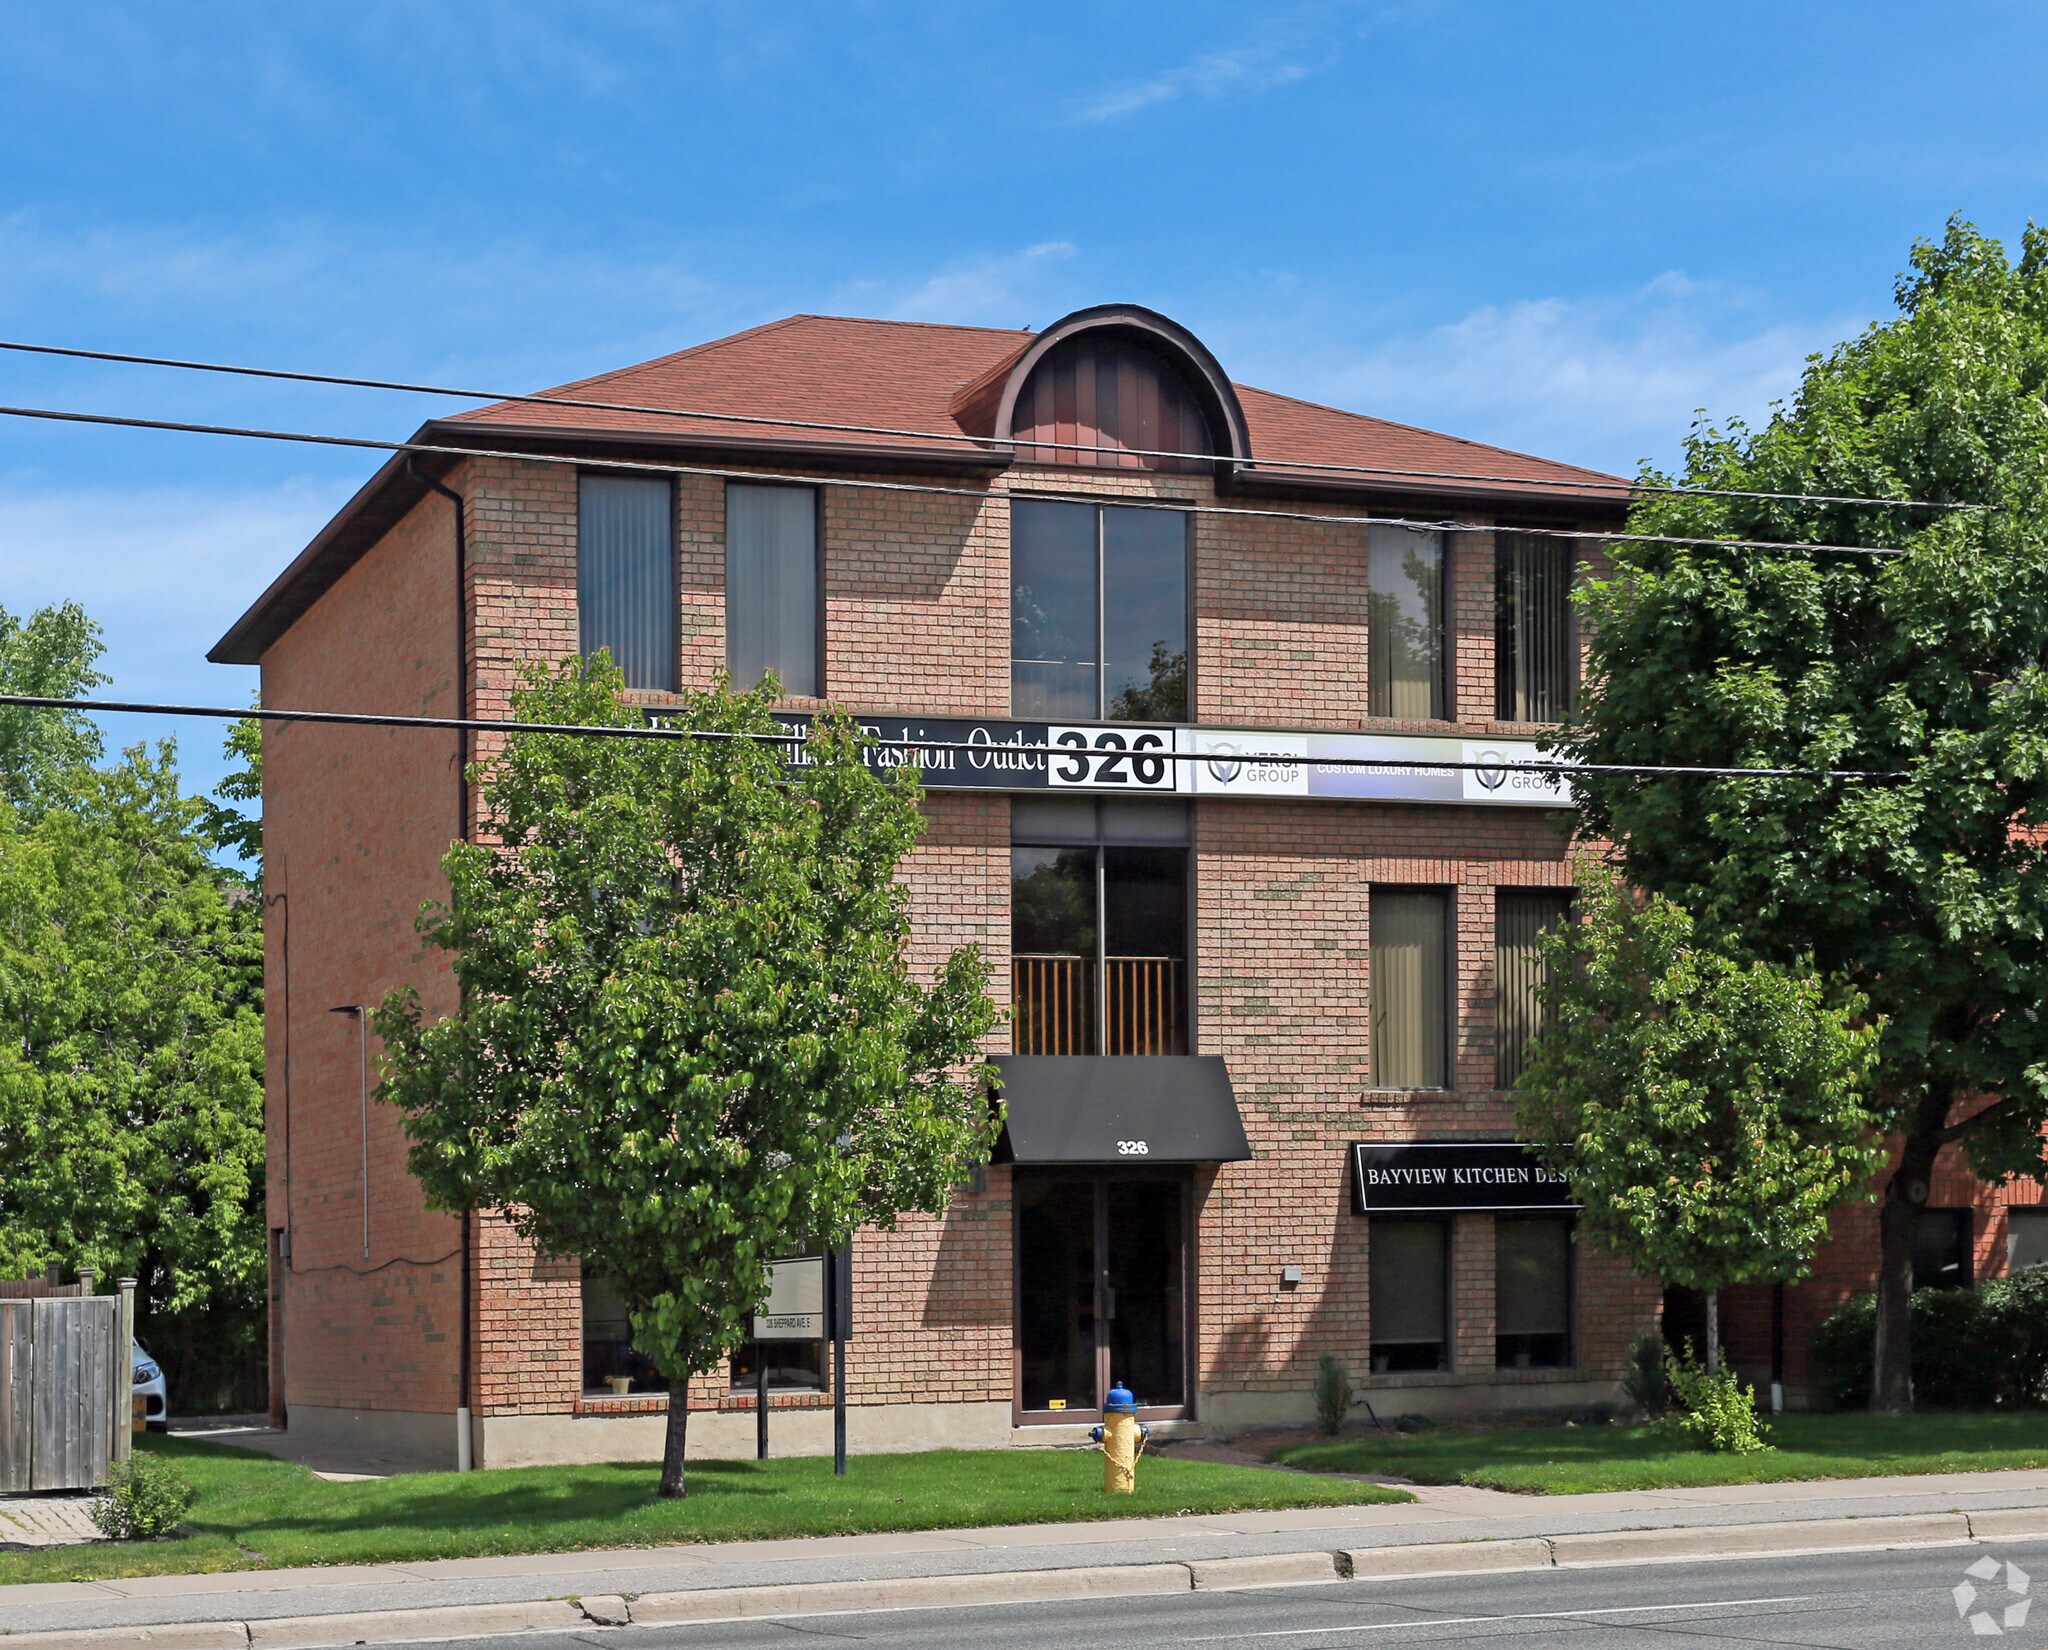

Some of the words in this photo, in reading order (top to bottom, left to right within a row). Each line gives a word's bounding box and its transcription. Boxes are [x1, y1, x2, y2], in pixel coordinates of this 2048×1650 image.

[861, 726, 956, 769] Fashion
[967, 728, 1046, 770] Outlet
[1056, 731, 1166, 784] 326
[1246, 769, 1299, 783] GROUP
[1317, 759, 1365, 774] CUSTOM
[1368, 760, 1410, 775] LUXURY
[1414, 761, 1454, 777] HOMES
[1512, 776, 1560, 790] GROU
[1116, 1140, 1149, 1155] 326
[1368, 1168, 1447, 1185] BAYVIEW
[1453, 1167, 1529, 1184] KITCHEN
